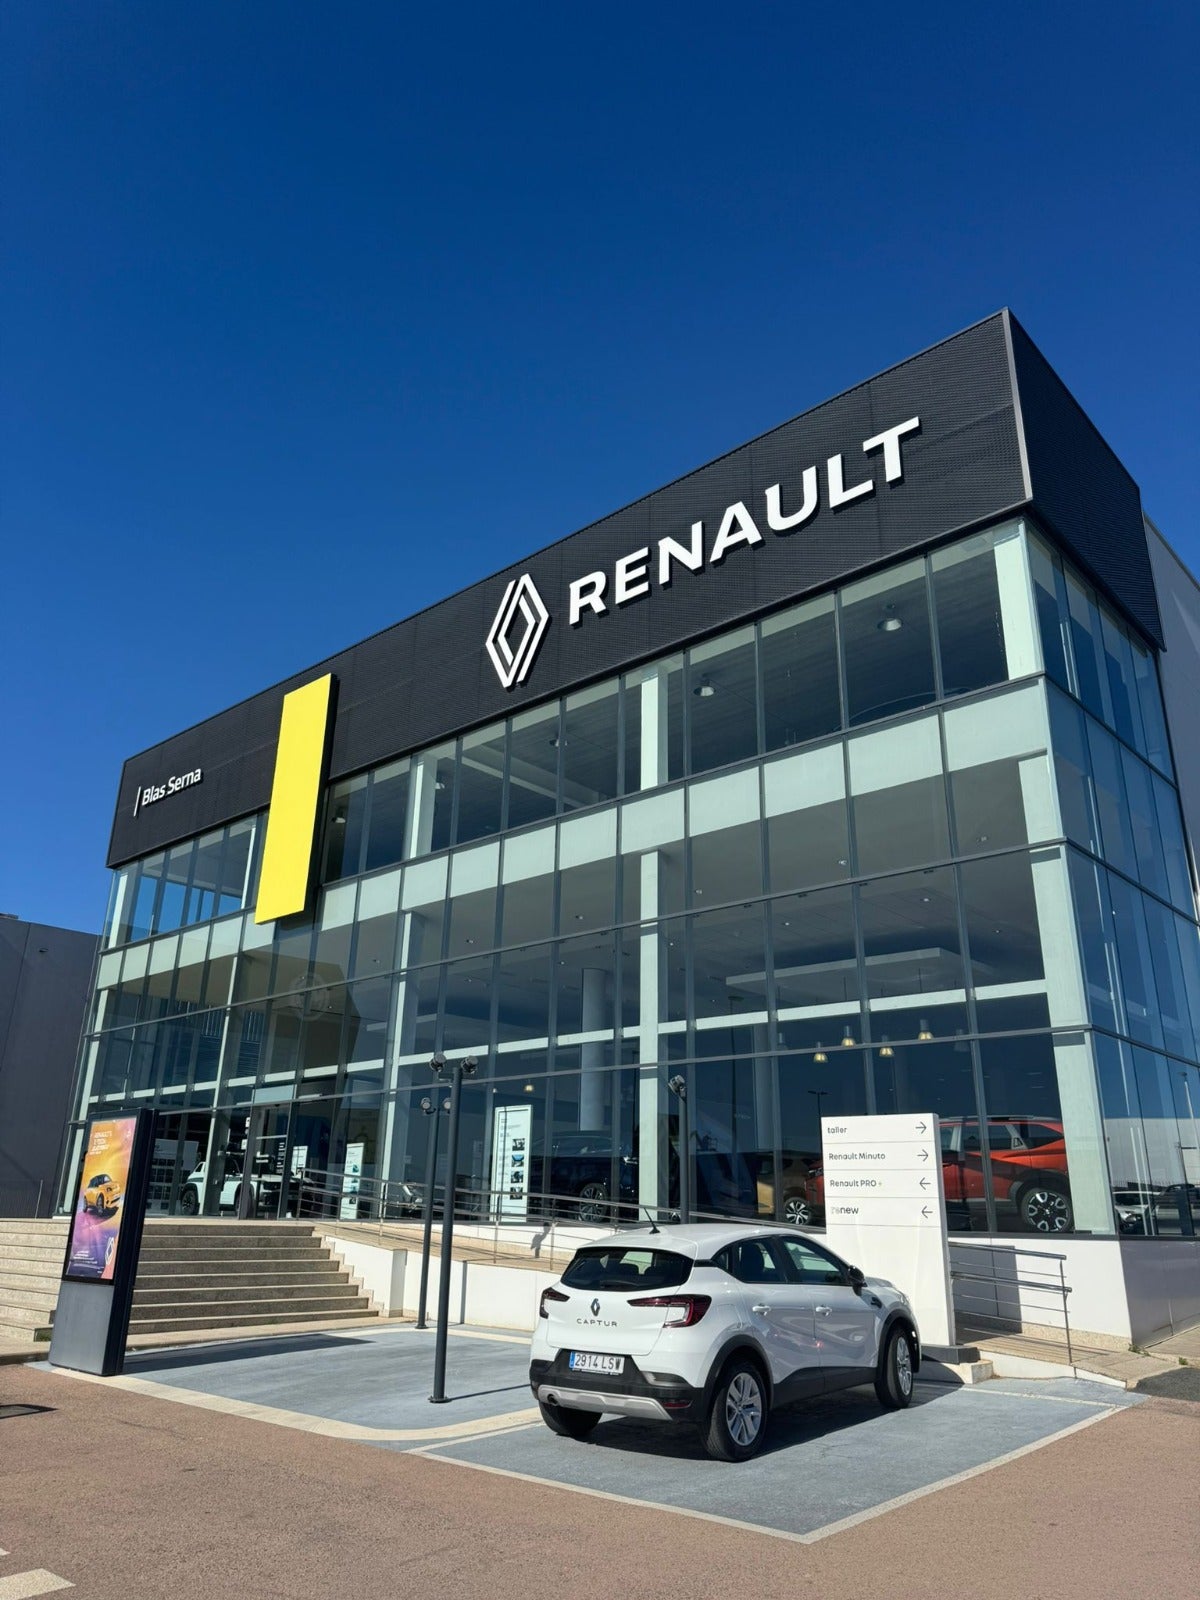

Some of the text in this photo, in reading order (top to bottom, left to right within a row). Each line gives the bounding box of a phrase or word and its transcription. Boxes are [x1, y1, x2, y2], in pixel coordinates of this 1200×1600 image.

[569, 416, 920, 626] RENAULT
[142, 768, 201, 806] Blas Serna
[859, 1152, 886, 1160] Minuto
[860, 1179, 877, 1187] PRO
[576, 1318, 618, 1327] CAPTUR
[575, 1354, 621, 1370] 2914 LSW
